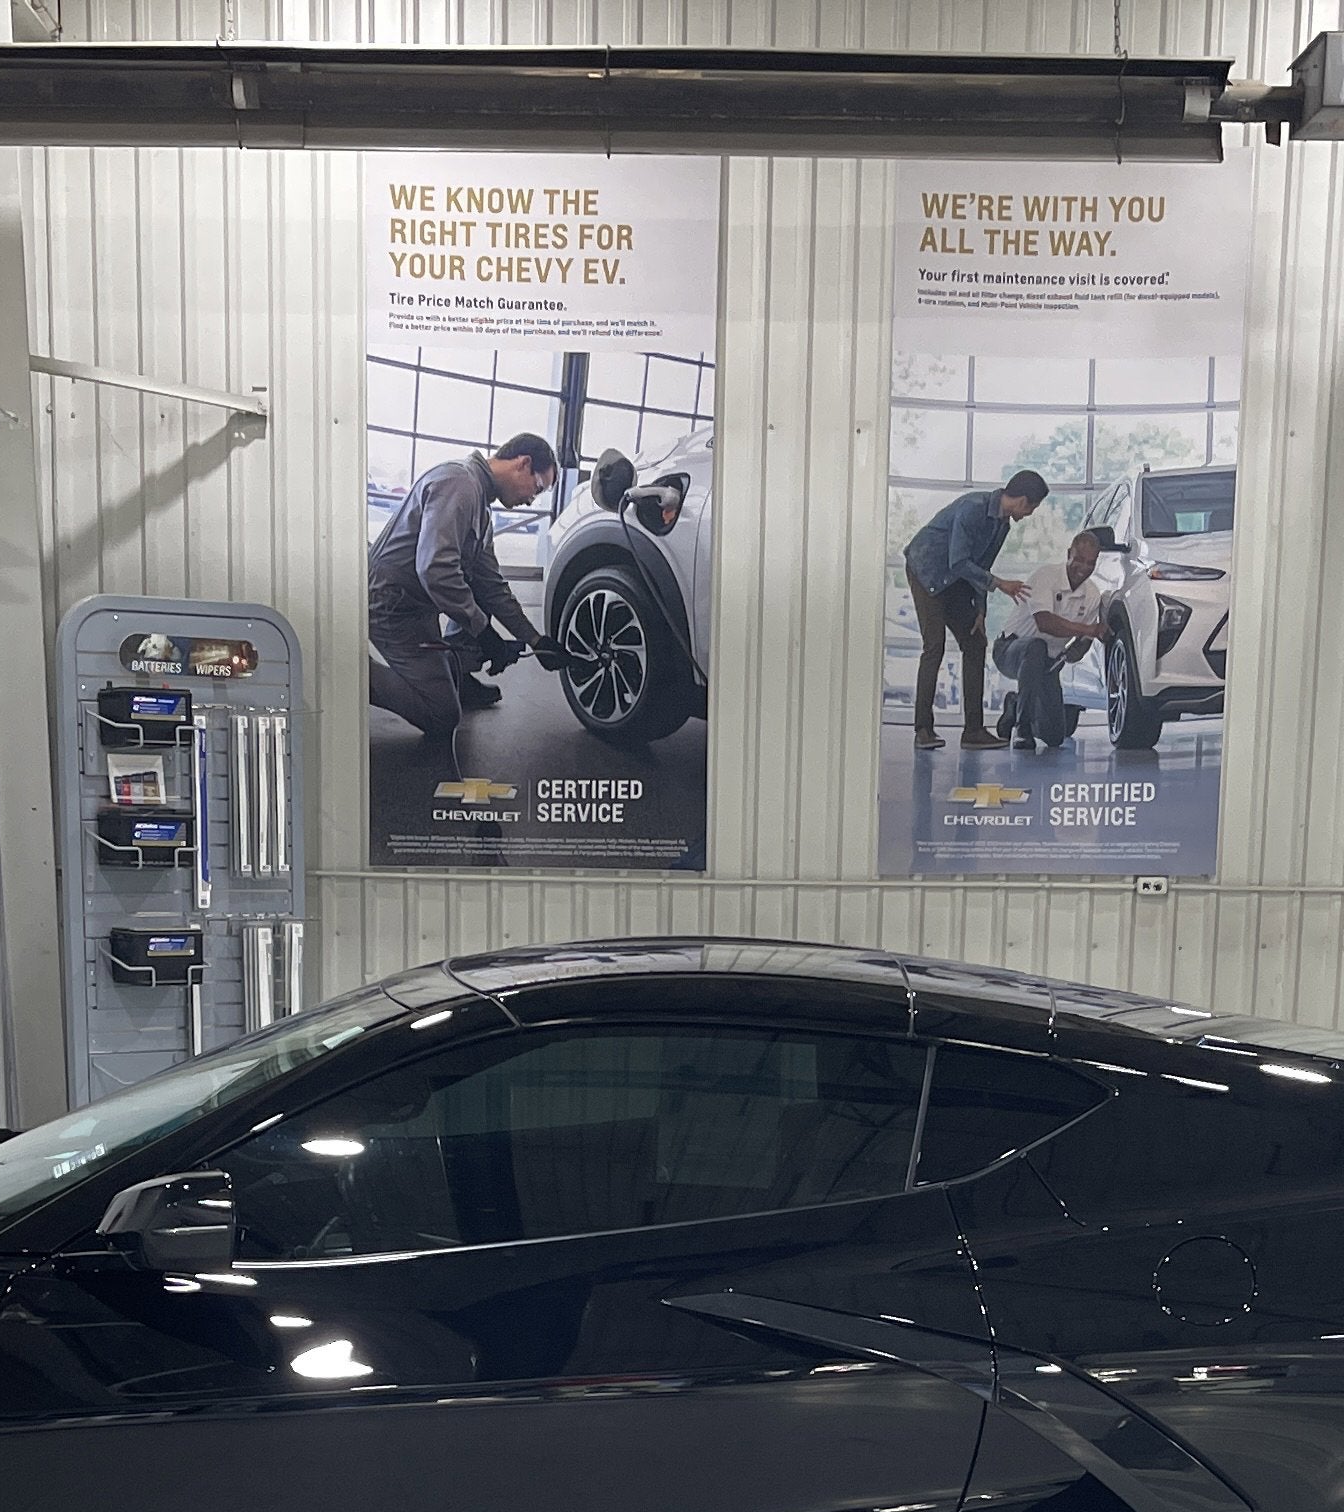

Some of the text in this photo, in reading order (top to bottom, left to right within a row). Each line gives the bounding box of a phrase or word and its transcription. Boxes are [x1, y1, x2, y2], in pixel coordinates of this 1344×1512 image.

[389, 184, 598, 215] WE KNOW THE
[921, 192, 1165, 223] WE'RE WITH YOU
[390, 218, 633, 250] RIGHT TIRES FOR
[919, 226, 1117, 256] ALL THE WAY.
[389, 252, 626, 285] YOUR CHEVY EV.
[918, 268, 947, 282] Your
[951, 269, 979, 283] first
[983, 271, 1065, 285] maintenance
[1068, 273, 1096, 285] visit
[1099, 273, 1110, 285] is
[389, 292, 567, 311] Tire Price Match Guarantee.
[131, 660, 182, 674] BATTERIES
[196, 664, 231, 677] WIPERS
[537, 779, 643, 800] CERTIFIED
[1050, 782, 1156, 803] CERTIFIED
[432, 809, 521, 822] CHEVROLET
[537, 802, 624, 823] SERVICE
[944, 814, 1033, 827] CHEVROLET
[1049, 806, 1136, 827] SERVICE
